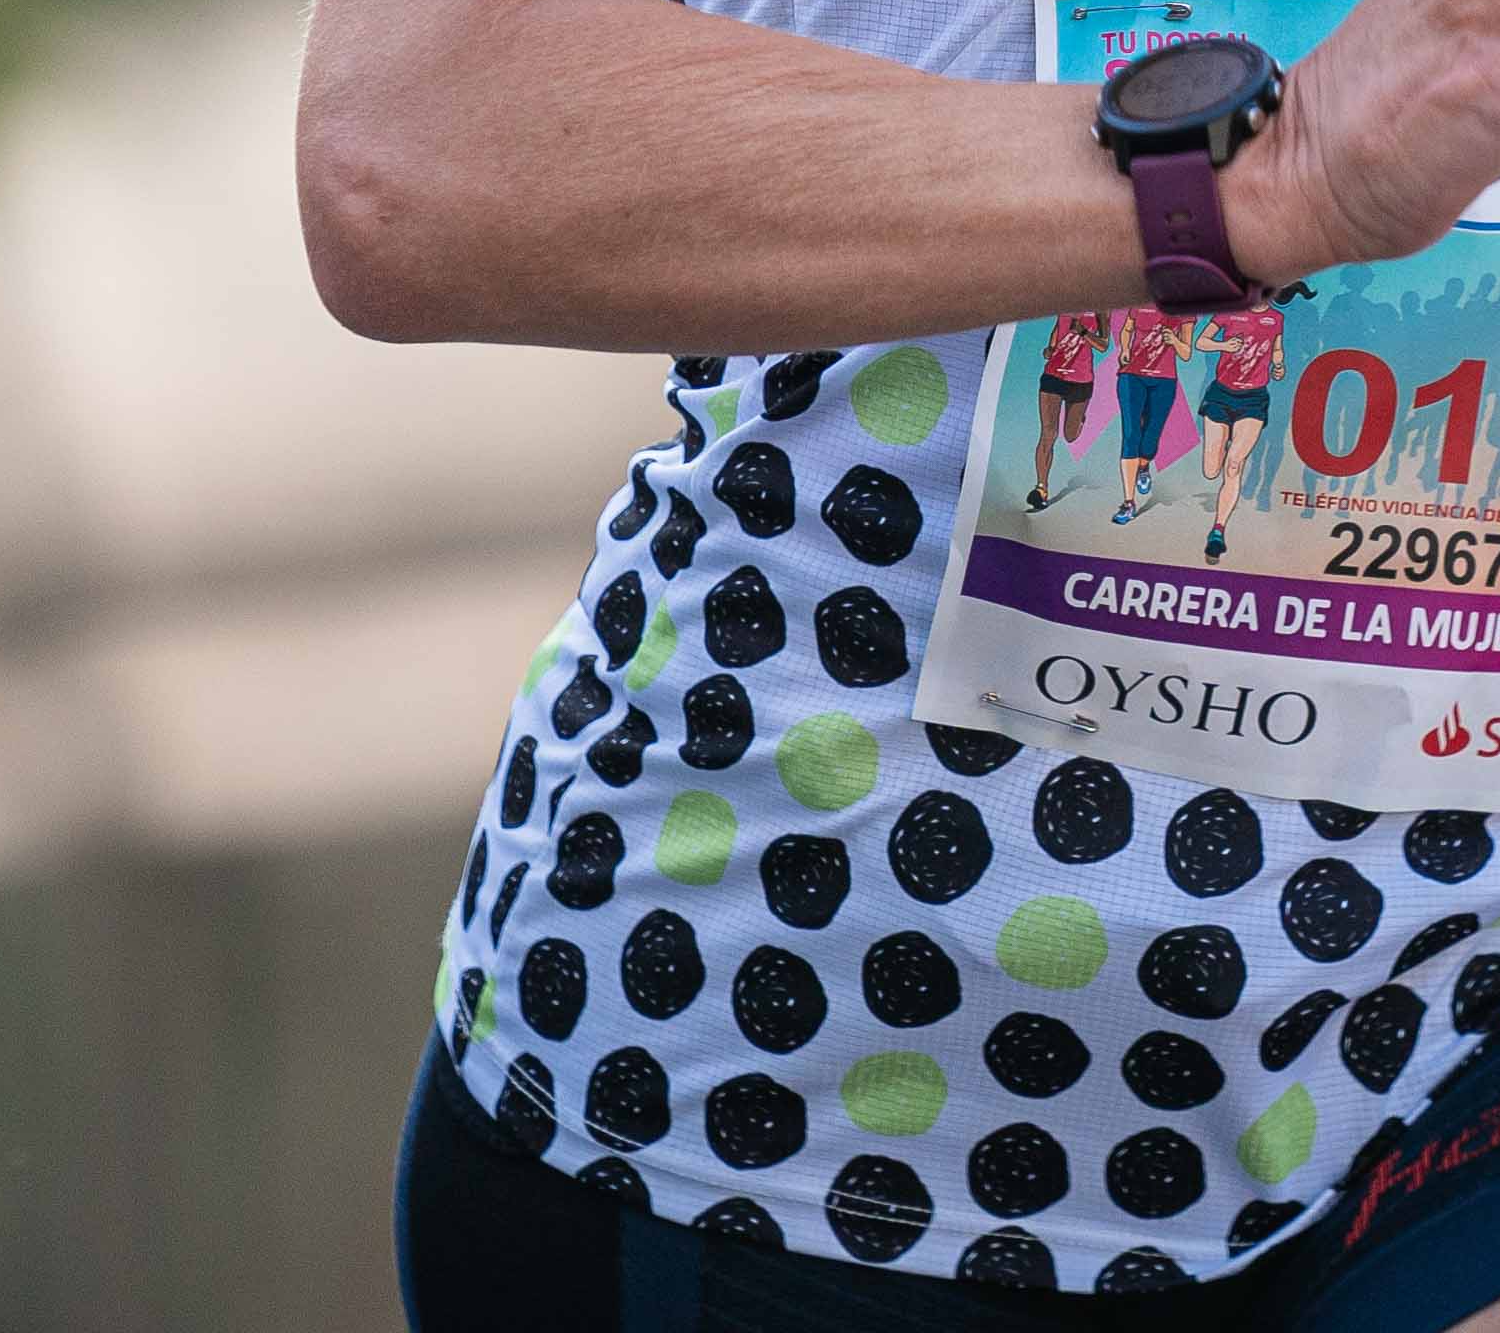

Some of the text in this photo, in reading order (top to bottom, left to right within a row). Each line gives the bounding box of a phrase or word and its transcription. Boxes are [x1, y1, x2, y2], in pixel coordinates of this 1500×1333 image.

[1101, 31, 1137, 54] TU
[1281, 491, 1377, 513] TELÉFONO
[1382, 500, 1478, 520] VIOLENCIA
[1063, 572, 1258, 631] CARRERA
[1274, 595, 1331, 638] DE
[1341, 601, 1392, 644] LA
[1034, 654, 1318, 747] OYSHO
